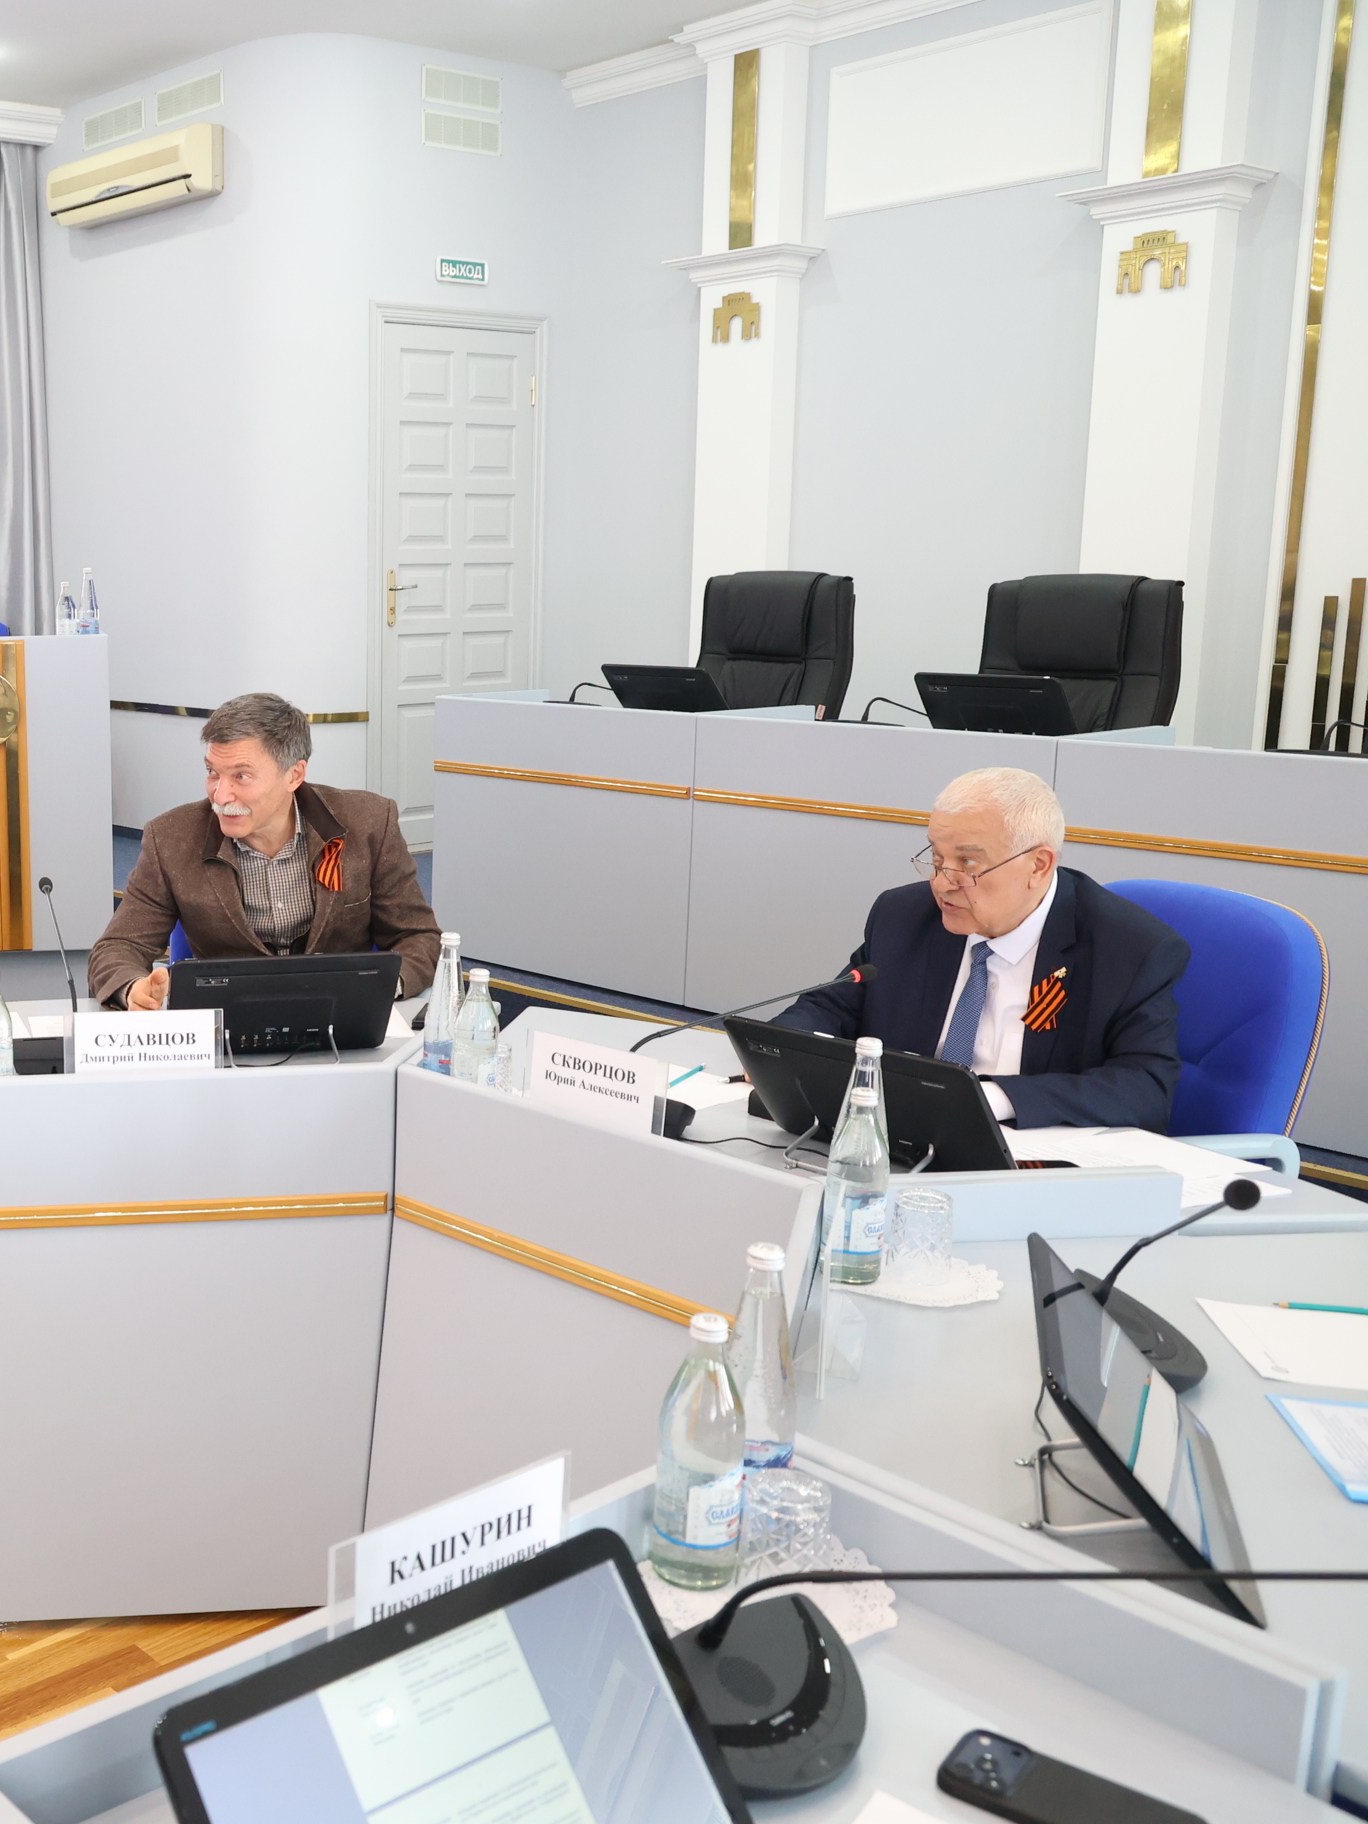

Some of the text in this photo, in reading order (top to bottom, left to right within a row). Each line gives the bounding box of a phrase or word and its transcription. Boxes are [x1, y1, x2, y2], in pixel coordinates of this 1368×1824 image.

[442, 262, 483, 280] ВЫХОД
[94, 1032, 197, 1048] СУДАВЦОВ
[80, 1051, 211, 1065] Дмитрий Николаевич
[551, 1051, 637, 1085] СКВОРЦОВ
[544, 1069, 640, 1104] Юрий Алексеевич
[389, 1504, 534, 1586] КАШУРИН
[371, 1538, 548, 1625] Николай Иванович
